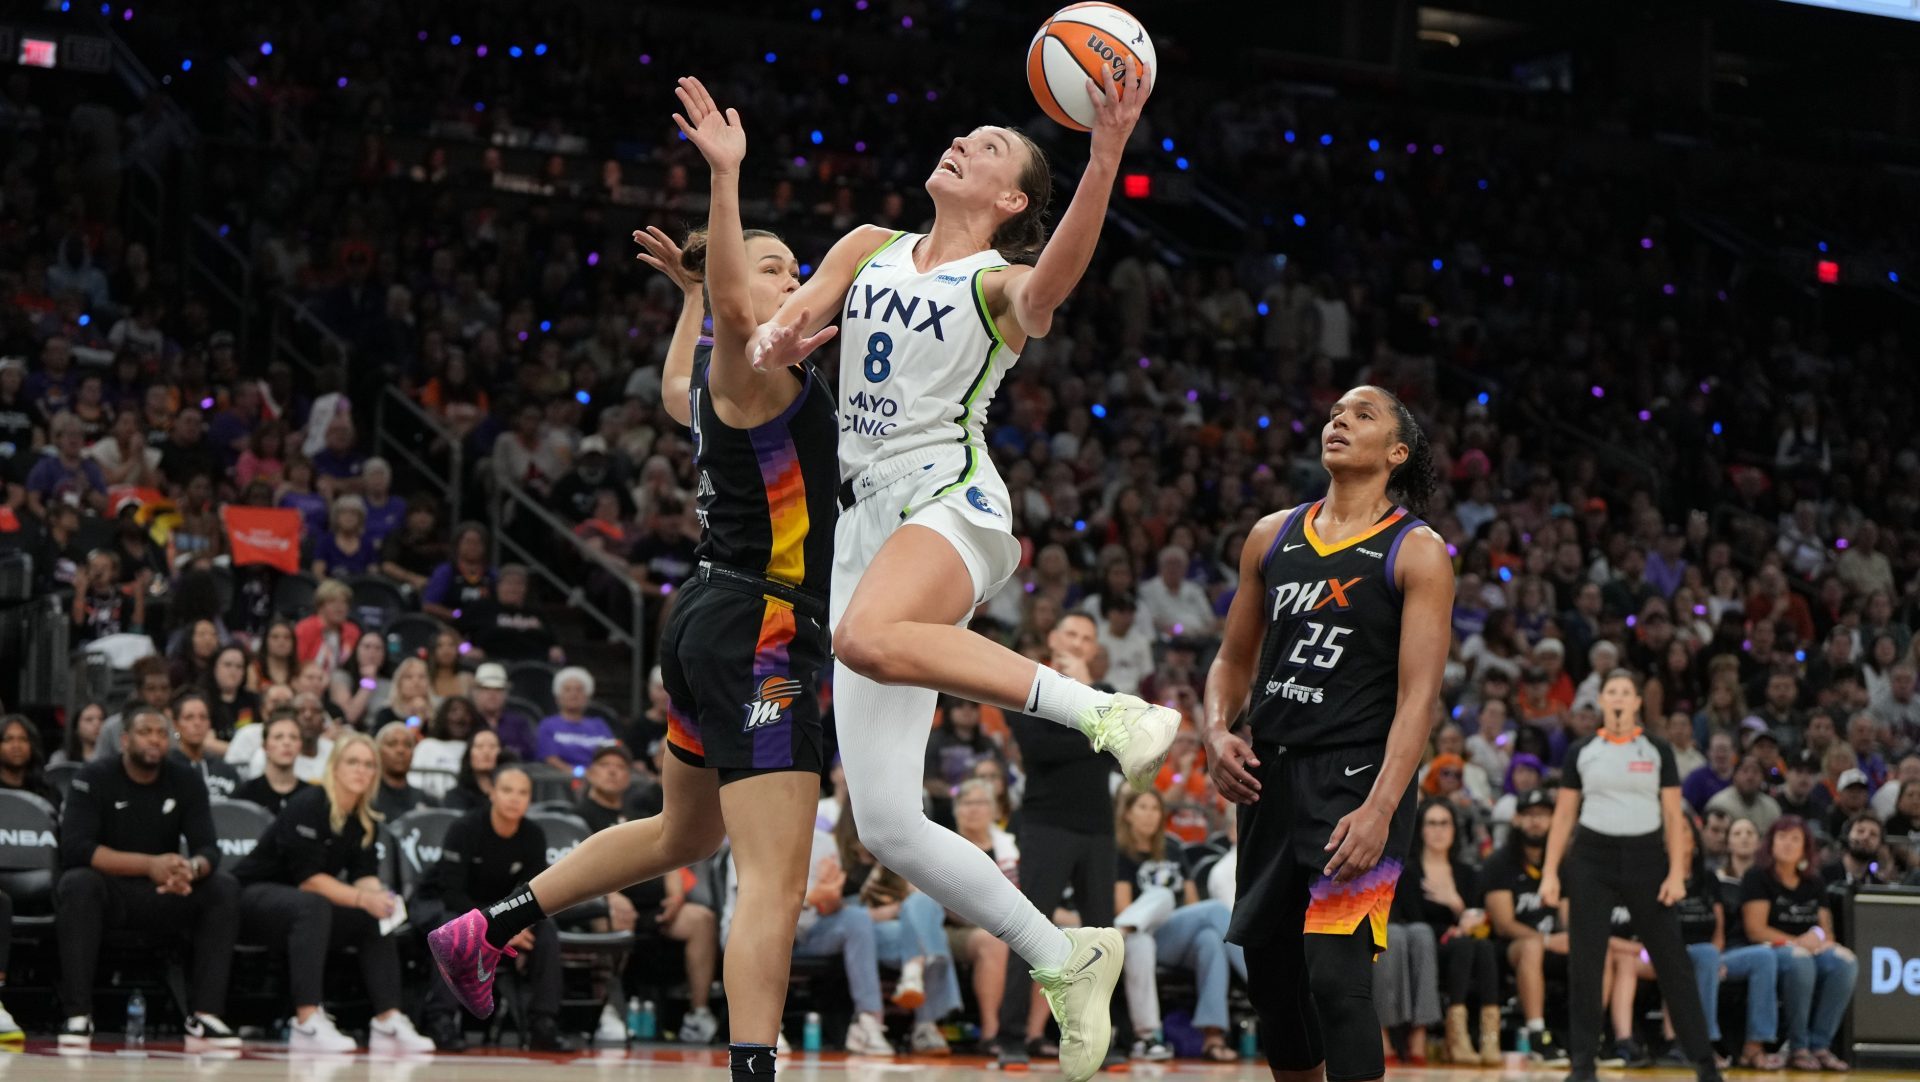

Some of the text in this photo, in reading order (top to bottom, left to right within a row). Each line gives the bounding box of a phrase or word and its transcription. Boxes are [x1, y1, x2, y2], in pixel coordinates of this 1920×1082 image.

[846, 284, 956, 342] LYNX
[864, 331, 893, 383] 8
[849, 391, 898, 418] MAYO
[1272, 577, 1364, 622] PHX
[1288, 621, 1354, 669] 25
[1870, 945, 1920, 996] De
